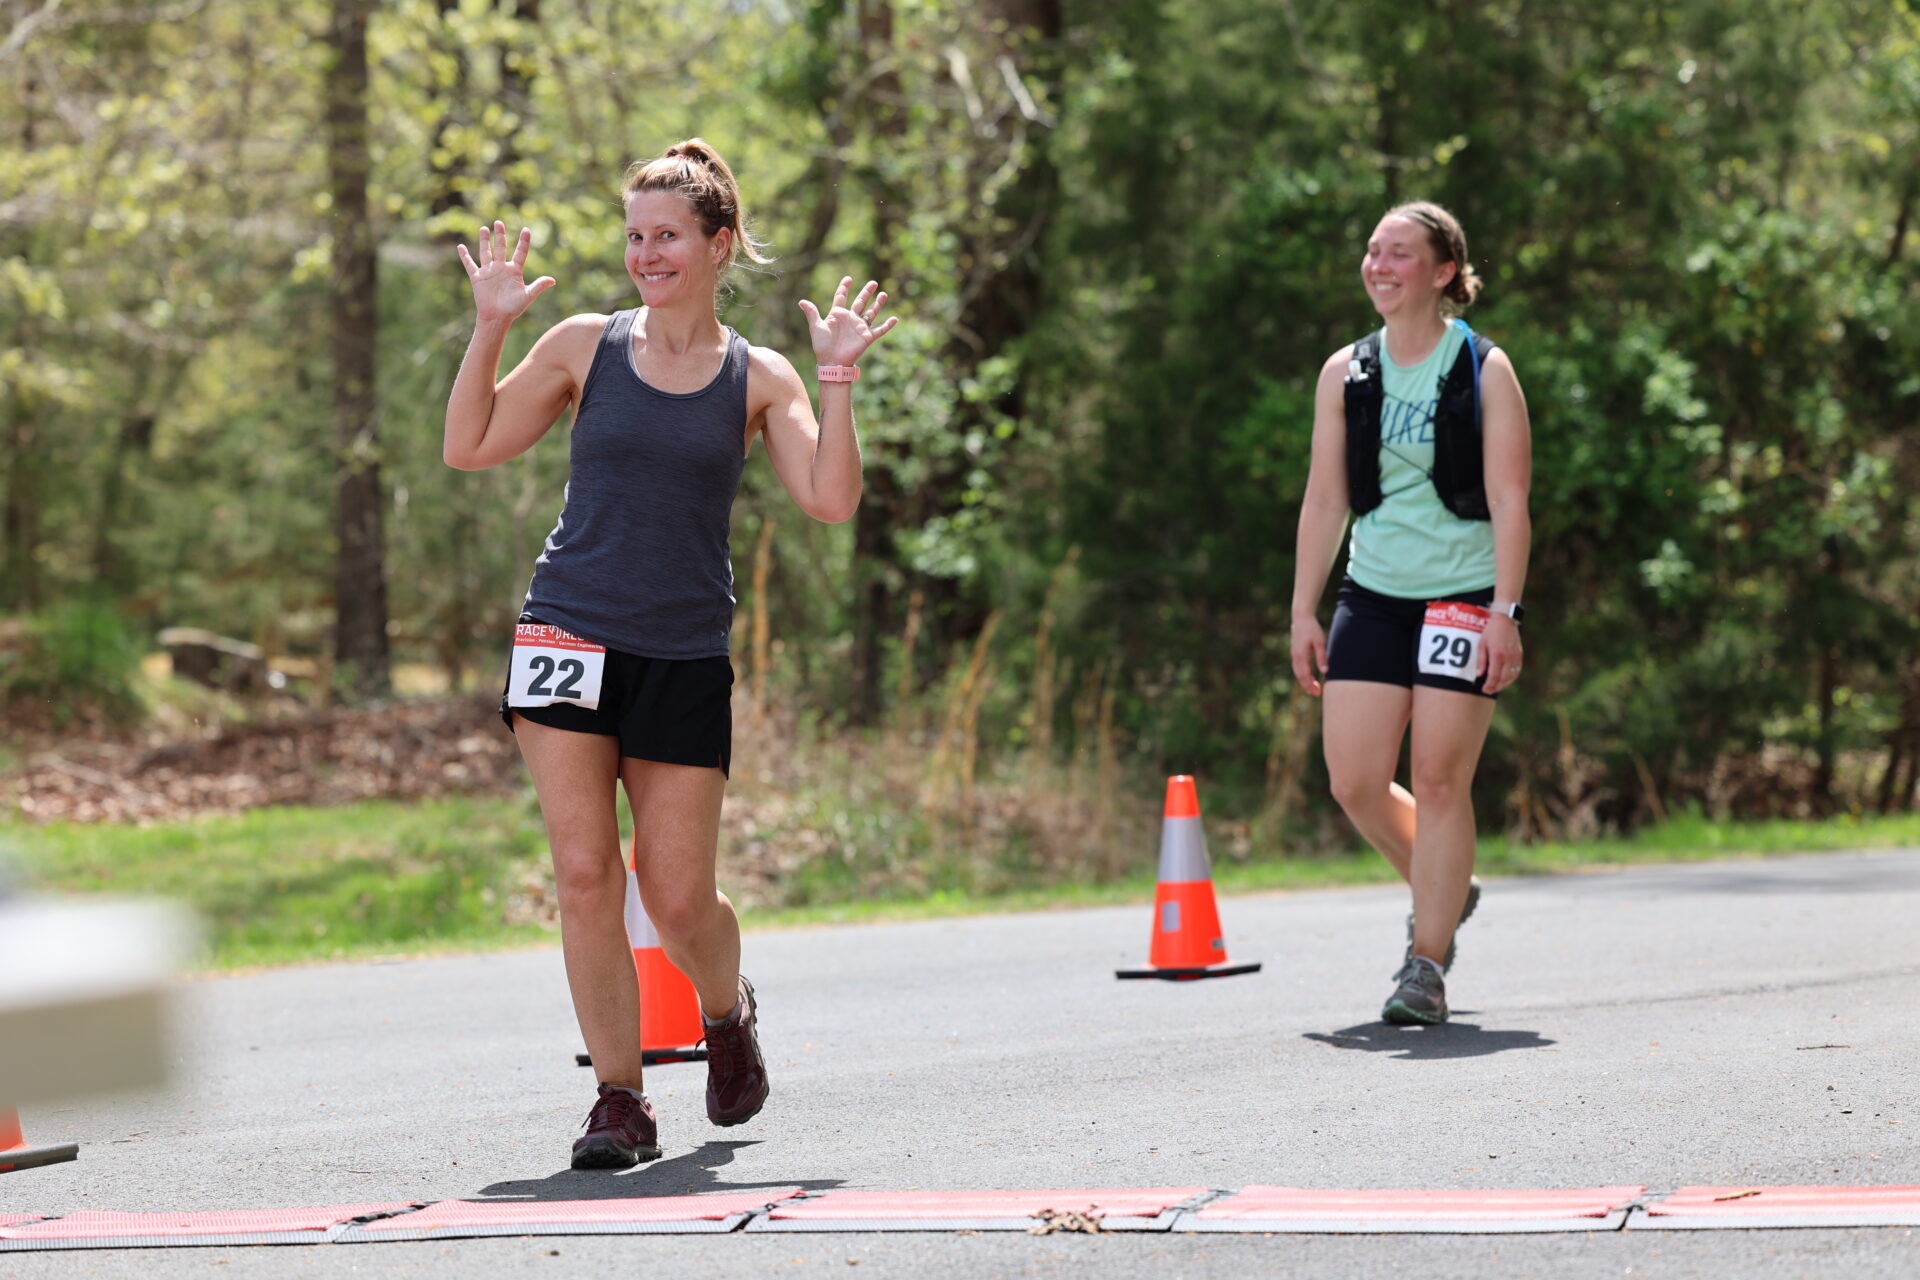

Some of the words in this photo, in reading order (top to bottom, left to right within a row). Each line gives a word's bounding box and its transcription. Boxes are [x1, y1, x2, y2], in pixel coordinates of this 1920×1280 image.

[516, 624, 548, 637] RACE
[1429, 633, 1472, 669] 29
[527, 655, 585, 700] 22
